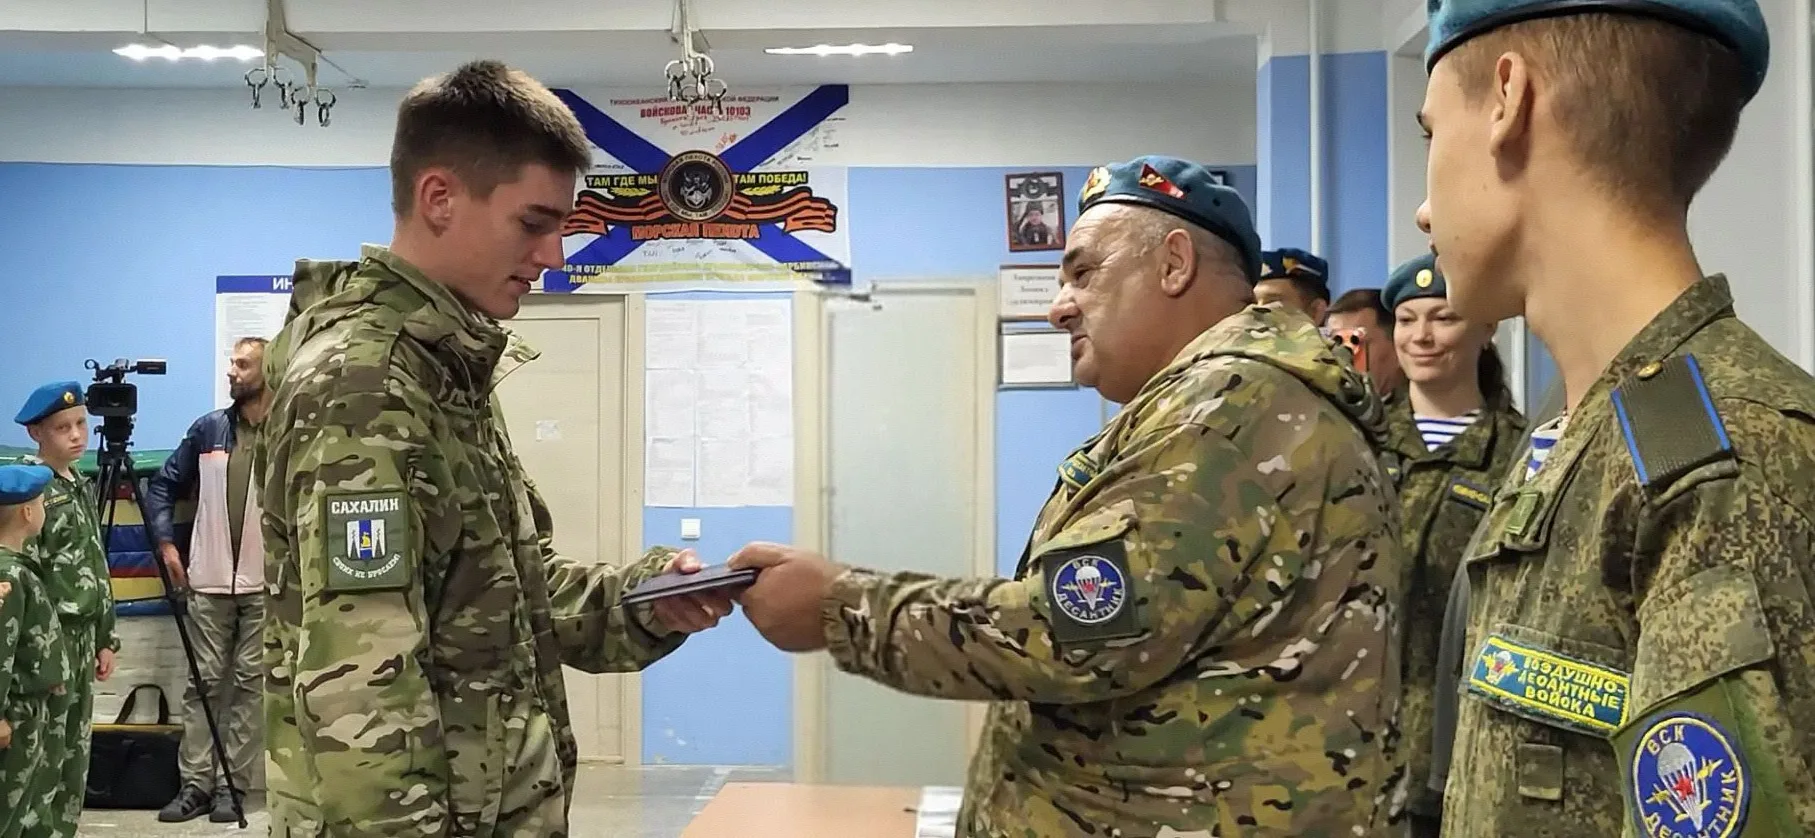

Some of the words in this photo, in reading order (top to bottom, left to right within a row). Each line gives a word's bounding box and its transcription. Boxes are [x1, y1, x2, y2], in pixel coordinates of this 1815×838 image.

[640, 105, 689, 118] ВОЙСКОВА
[725, 106, 751, 116] 10103
[586, 176, 611, 187] ТАМ
[613, 175, 636, 187] ГДЕ
[638, 175, 658, 185] МЫ
[734, 174, 756, 184] ТАМ
[758, 172, 807, 184] ПОБЕДА!
[632, 222, 700, 239] МОРСКАЯ
[702, 222, 760, 239] ПЕХОТА
[331, 498, 399, 514] САХАЛИН
[1072, 558, 1099, 570] ВСК
[1057, 588, 1122, 619] ДЕСАНТНИК
[1647, 725, 1685, 756] ВСК
